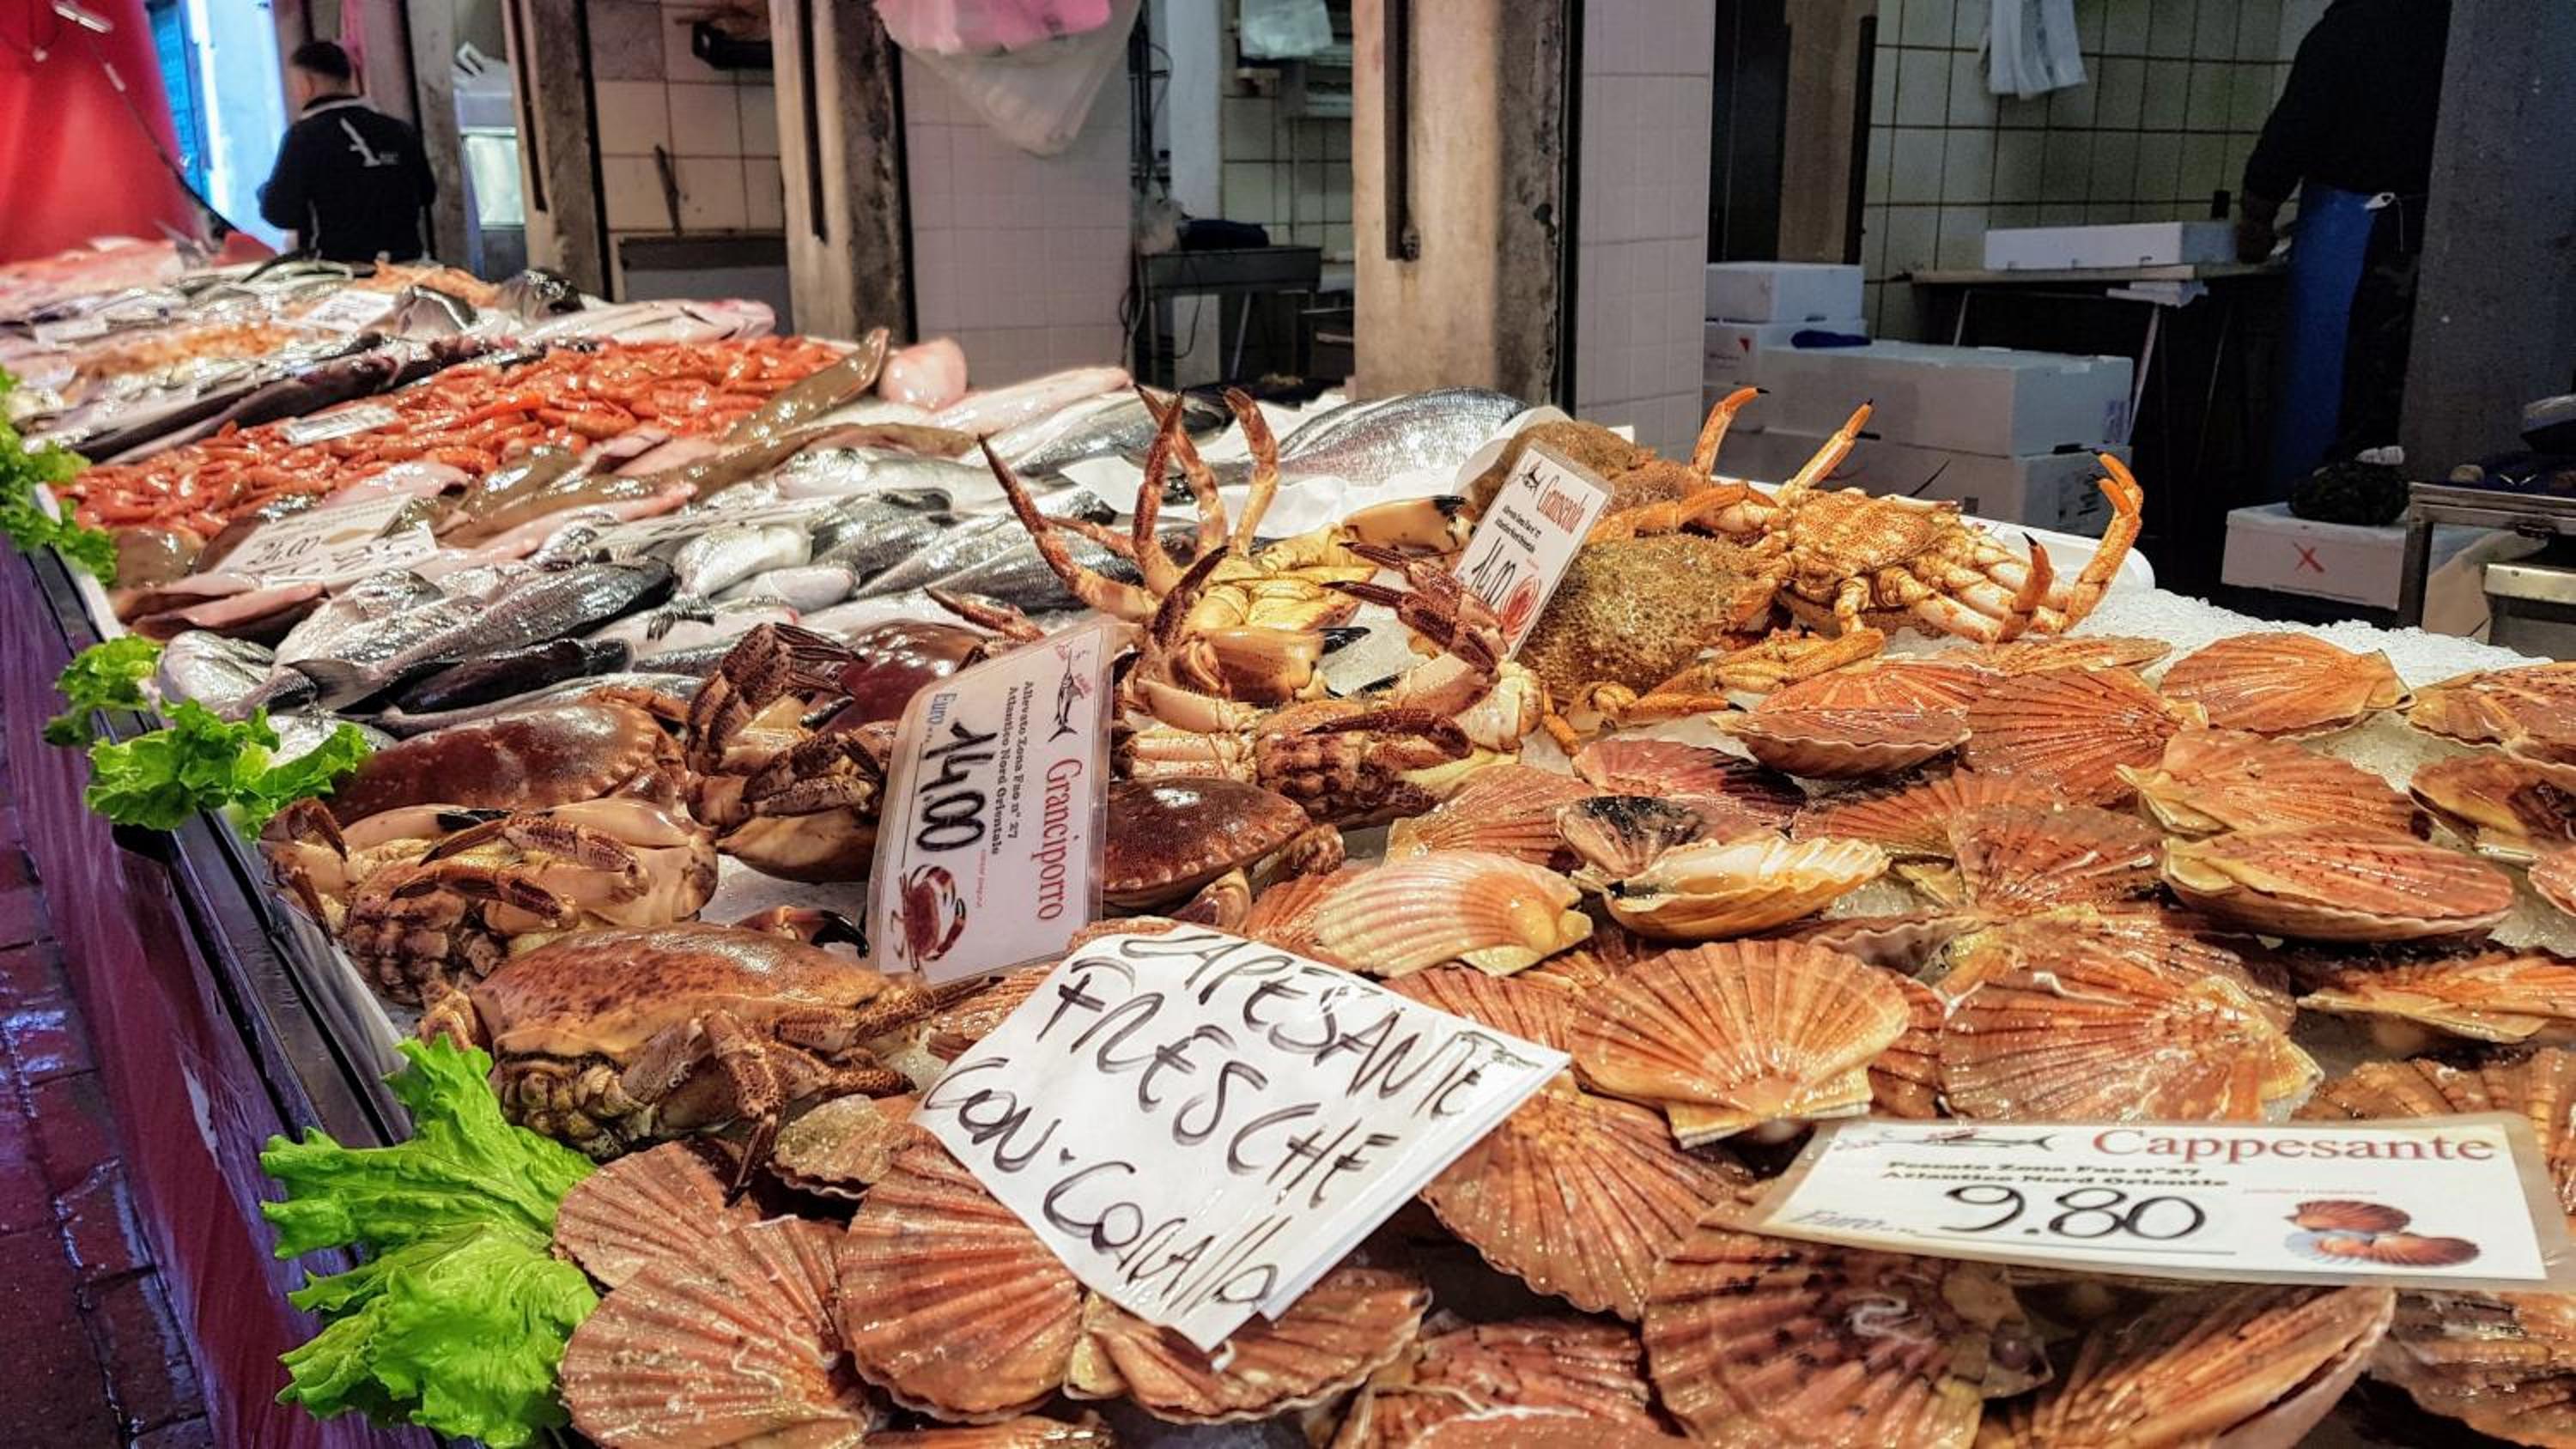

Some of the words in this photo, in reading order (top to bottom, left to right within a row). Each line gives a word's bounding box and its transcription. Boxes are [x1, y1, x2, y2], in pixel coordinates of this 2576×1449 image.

[1001, 687, 1018, 746] Atlantico
[998, 748, 1011, 785] Nord
[1014, 737, 1028, 772] Zona
[1007, 822, 1019, 839] 27
[1030, 759, 1083, 920] Granciporro
[1036, 956, 1399, 1208] FRESCHE
[2093, 1129, 2495, 1164] Cappesante
[1939, 1184, 2206, 1240] 9.80
